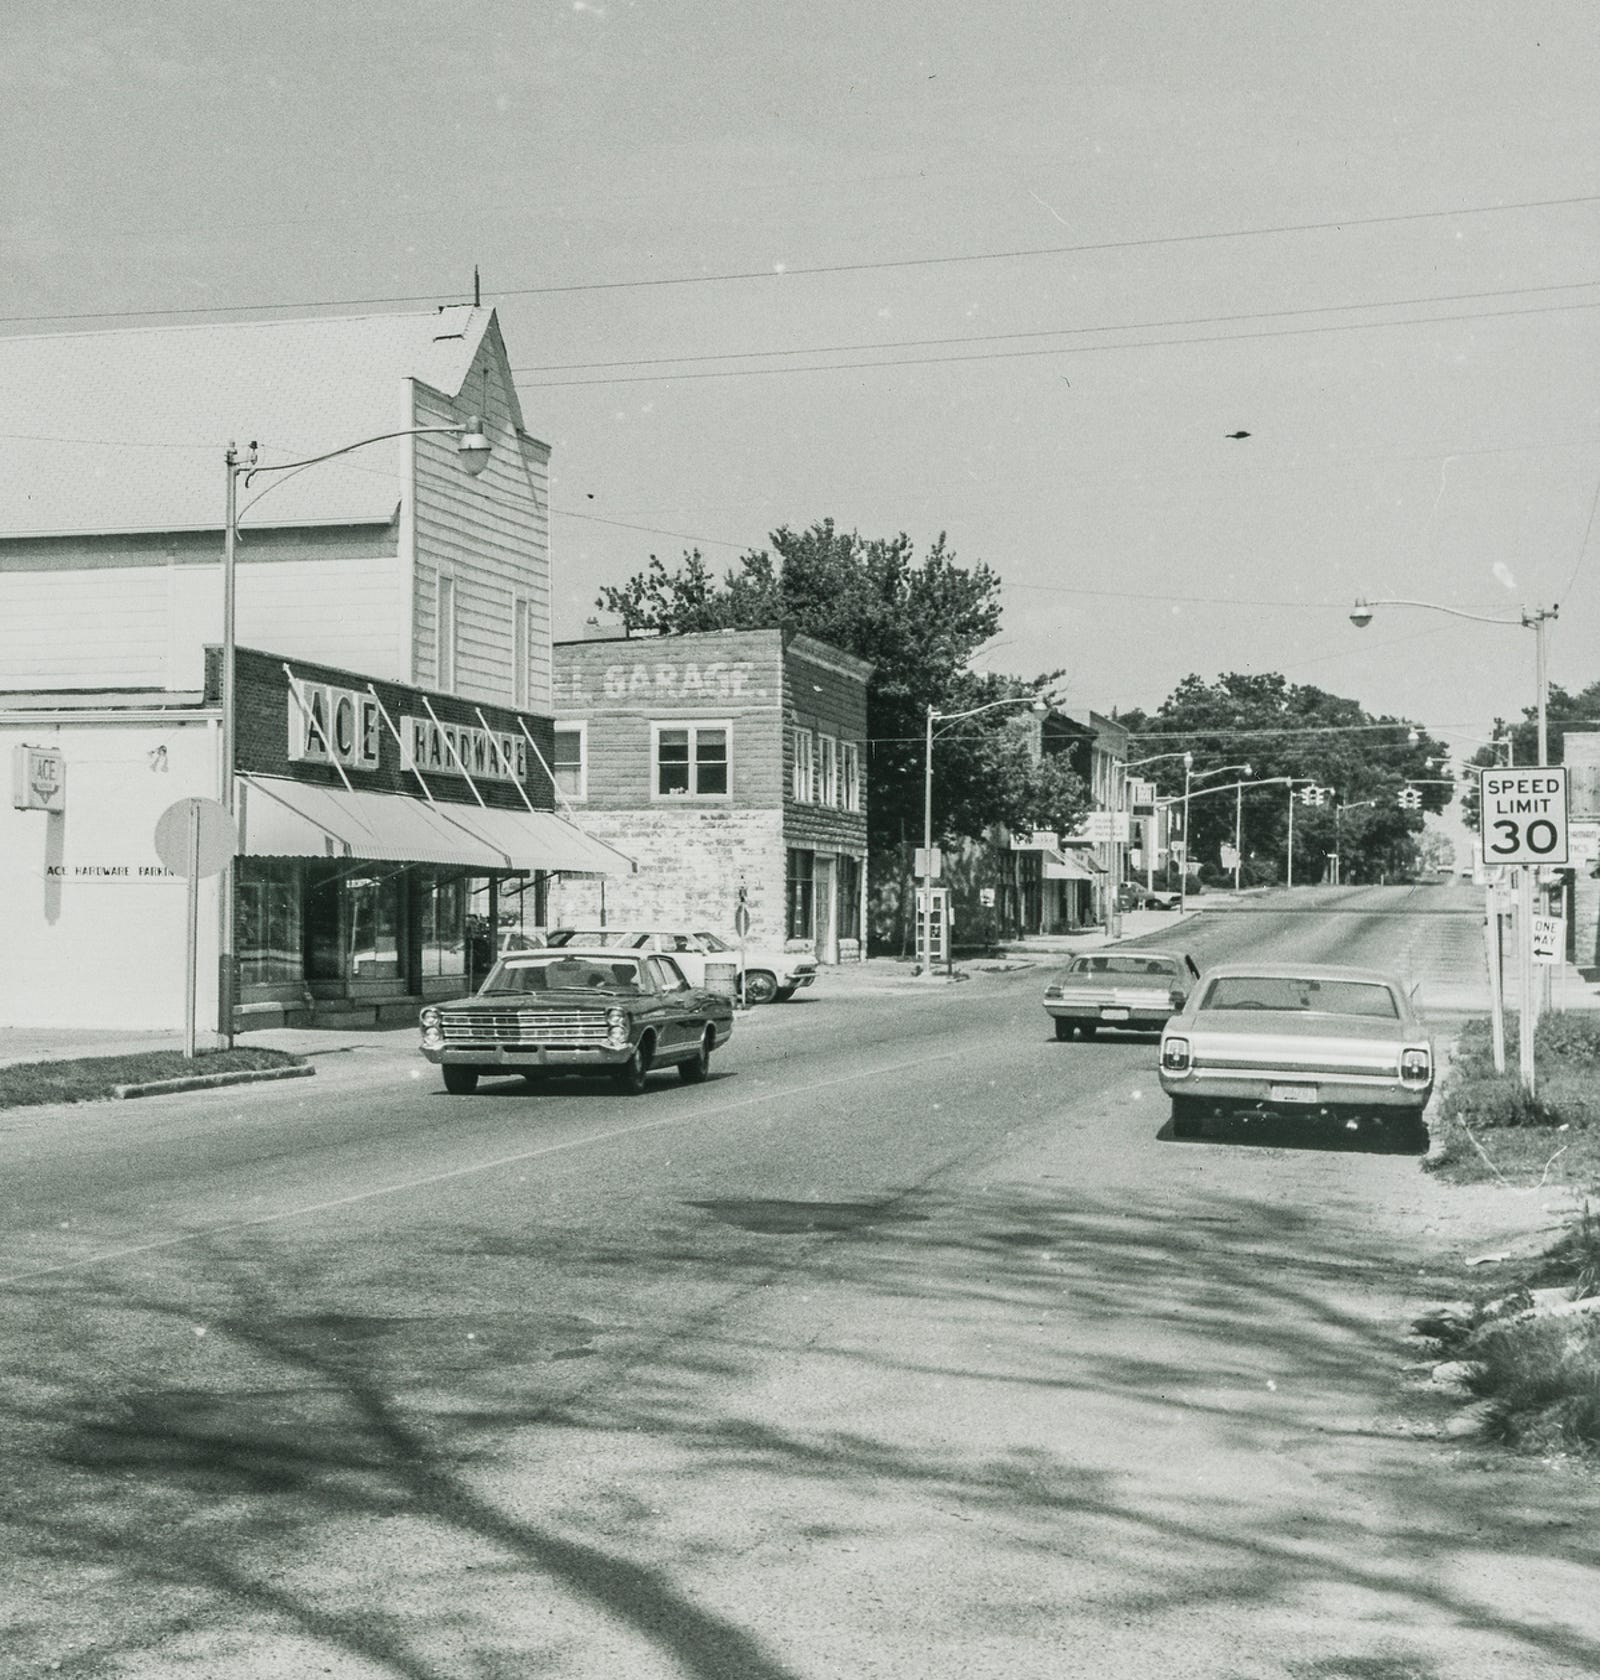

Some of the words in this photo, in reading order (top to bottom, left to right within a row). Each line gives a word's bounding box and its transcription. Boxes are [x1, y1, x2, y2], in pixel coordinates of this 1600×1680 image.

[306, 690, 377, 761] ACE
[414, 724, 526, 776] HARDWARE
[36, 759, 56, 781] ACE
[1487, 778, 1560, 795] SPEED
[1496, 798, 1551, 815] LIMIT
[1490, 819, 1558, 855] 30
[138, 866, 175, 877] PARKIN
[1534, 920, 1558, 934] ONE
[1533, 934, 1557, 946] WAY
